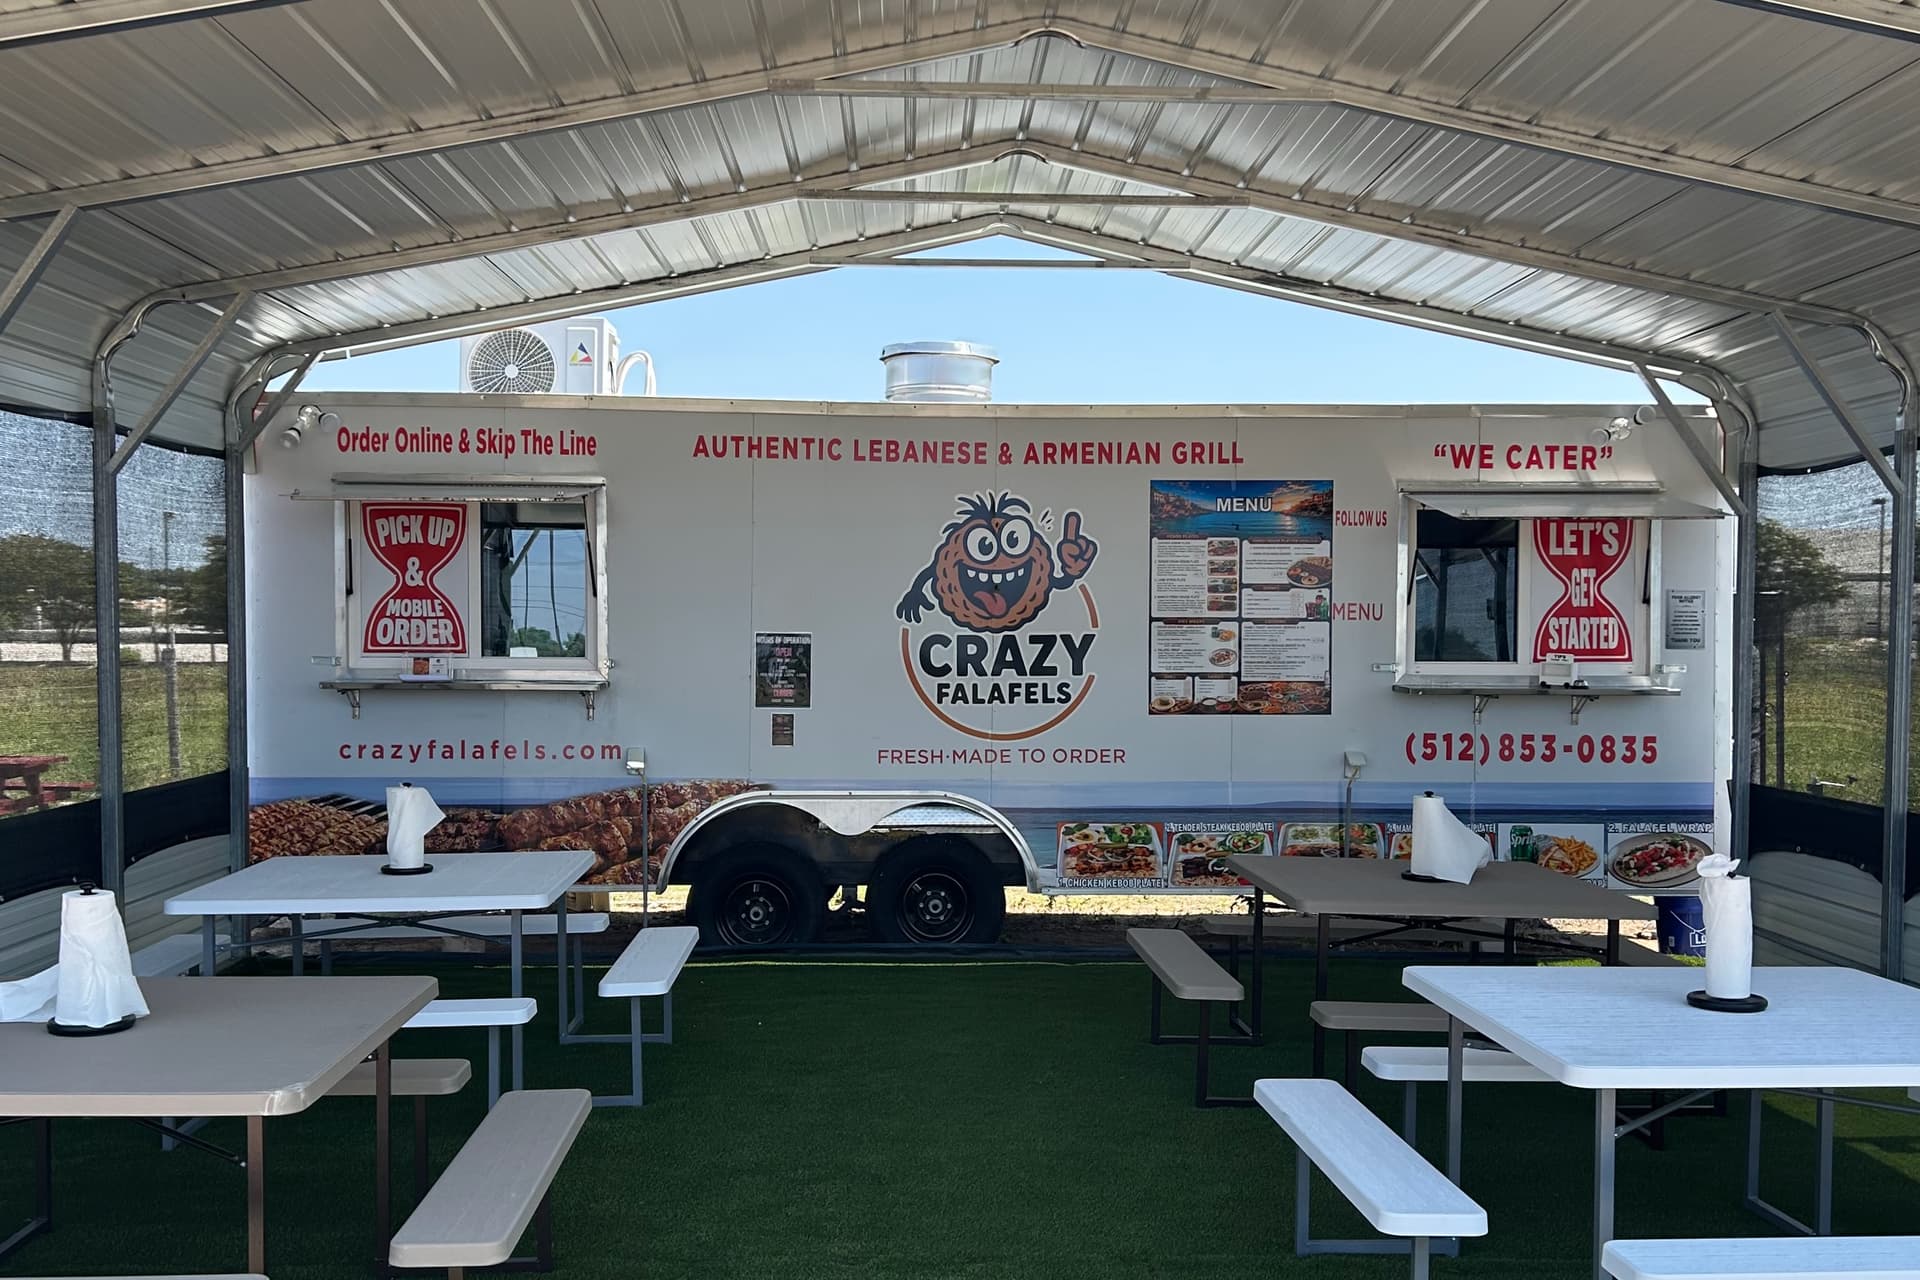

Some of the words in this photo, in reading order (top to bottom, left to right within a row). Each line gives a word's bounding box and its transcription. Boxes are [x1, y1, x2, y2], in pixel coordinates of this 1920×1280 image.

[337, 427, 390, 453] Order
[395, 427, 453, 454] Online
[458, 428, 470, 454] &
[476, 428, 516, 458] Skip
[521, 429, 554, 455] The
[559, 430, 597, 456] Line
[693, 434, 842, 462] AUTHENTIC
[853, 439, 987, 465] LEBANESE
[998, 442, 1012, 465] &
[1023, 441, 1161, 465] ARMENIAN
[1171, 440, 1244, 465] GRILL
[1216, 497, 1273, 512] MENU
[1335, 510, 1373, 526] FOLLOW
[1375, 510, 1388, 526] US
[375, 515, 424, 548] PICK
[427, 516, 456, 547] UP
[1549, 521, 1620, 557] LET'S
[405, 556, 424, 587] &
[1571, 567, 1597, 607] GET
[386, 598, 445, 617] MOBILE
[1332, 602, 1384, 621] MENU
[375, 617, 456, 645] ORDER
[1548, 616, 1619, 650] STARTED
[919, 633, 1097, 678] CRAZY
[936, 682, 1072, 705] FALAFELS
[338, 739, 623, 763] crazyfalafels.com
[1017, 748, 1046, 764] TO
[1052, 748, 1127, 764] ORDER
[1405, 732, 1659, 765] (512)853-0835
[1174, 823, 1200, 832] TENDER
[1201, 823, 1225, 832] STEAK
[1226, 823, 1250, 832] KEBOB
[1252, 823, 1273, 832] PLATE
[1608, 823, 1618, 833] 2.
[1622, 823, 1672, 833] FALAFEL
[1677, 823, 1711, 833] WRAP
[1067, 878, 1104, 888] CHICKEN
[1106, 878, 1135, 888] KEBOB
[1137, 878, 1162, 888] PLATE
